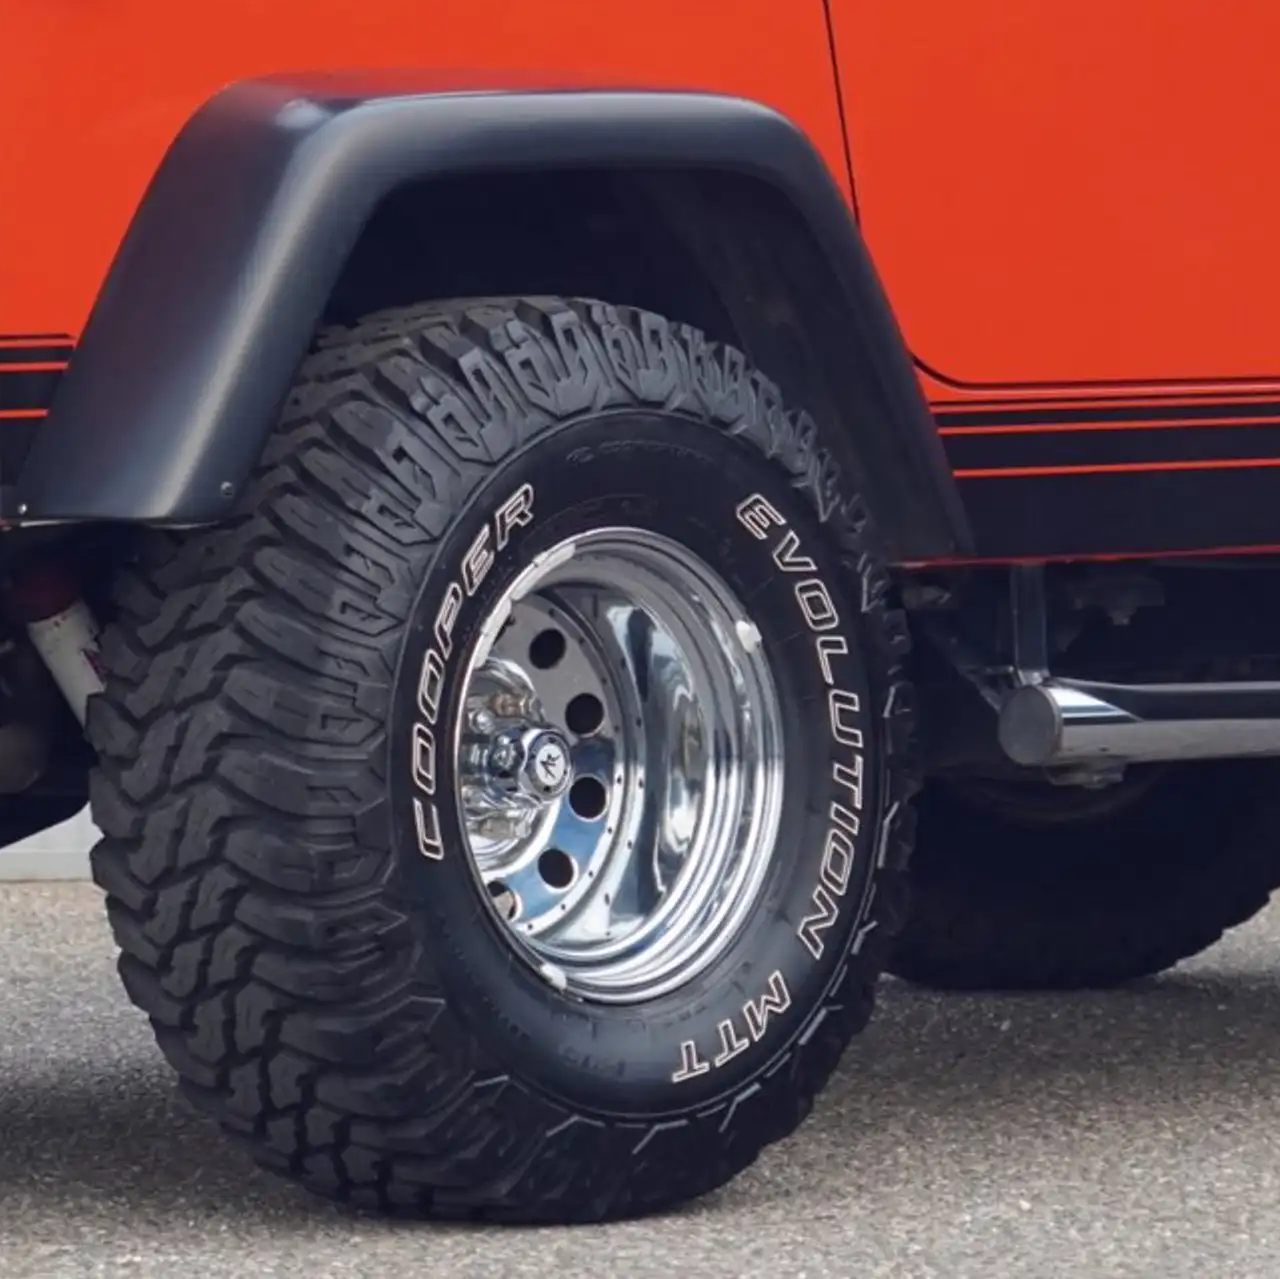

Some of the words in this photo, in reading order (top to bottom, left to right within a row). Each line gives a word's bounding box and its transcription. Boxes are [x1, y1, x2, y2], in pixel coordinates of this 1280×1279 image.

[412, 483, 534, 860] COOPER
[736, 493, 863, 960] EVOLUTION
[672, 970, 792, 1083] MTT
